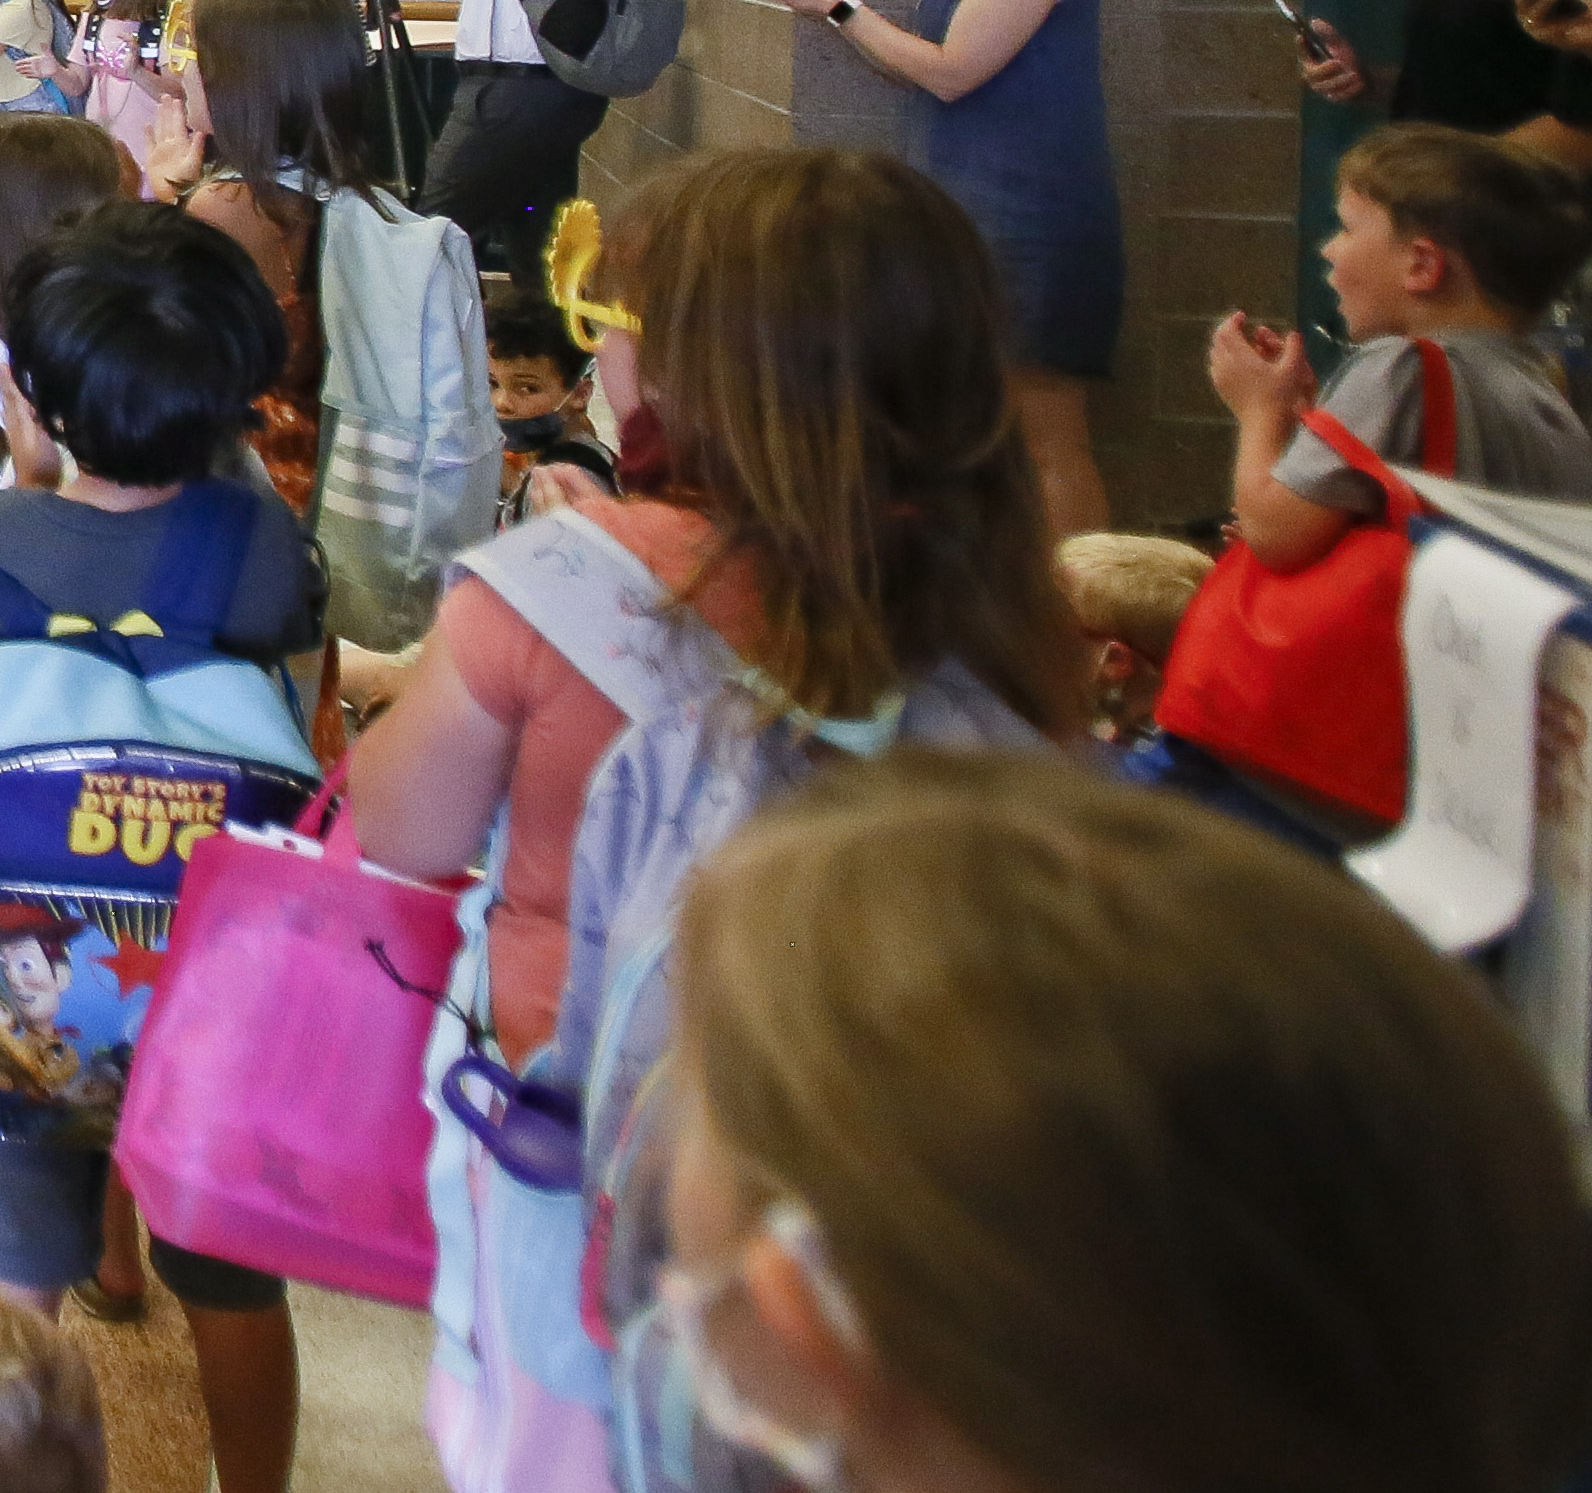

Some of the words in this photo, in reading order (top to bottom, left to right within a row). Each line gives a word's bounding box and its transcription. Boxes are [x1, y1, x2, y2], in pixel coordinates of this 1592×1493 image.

[82, 772, 127, 795] TOY
[132, 775, 228, 802] STORY'S
[79, 791, 226, 825] DYNAMIC
